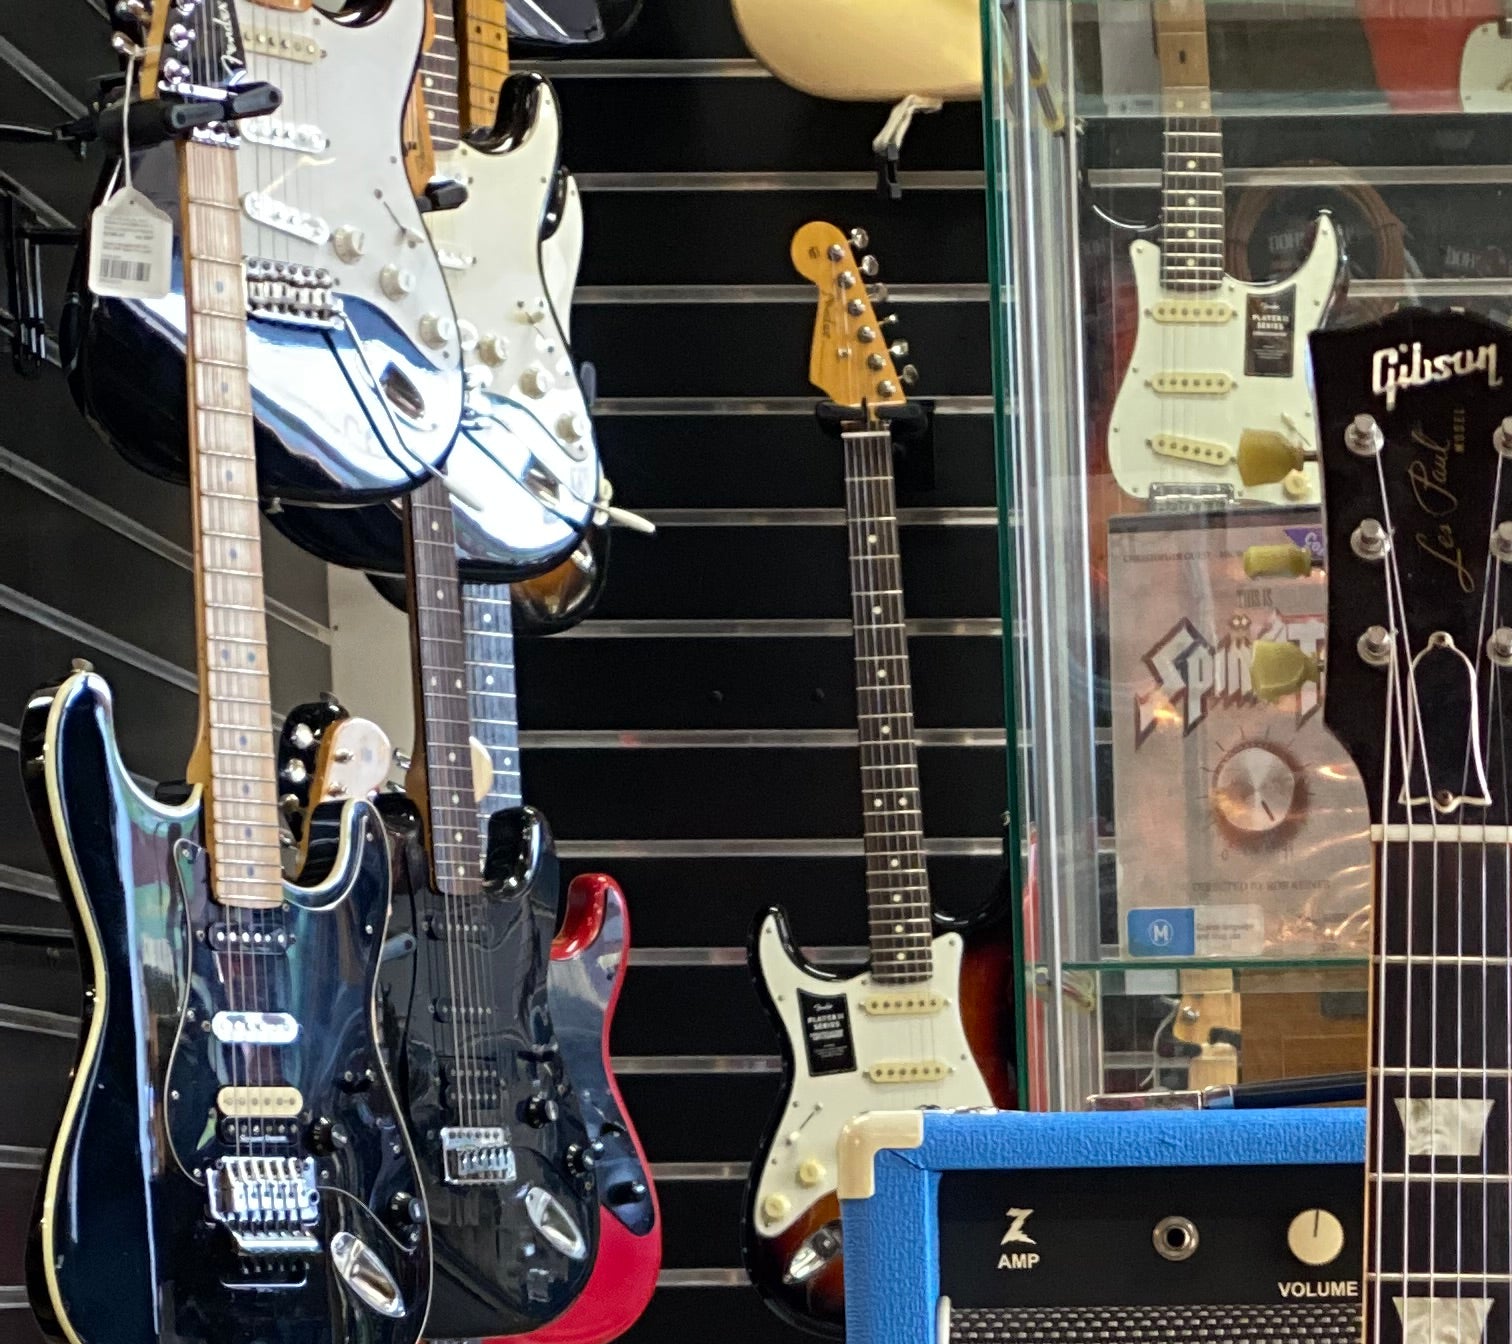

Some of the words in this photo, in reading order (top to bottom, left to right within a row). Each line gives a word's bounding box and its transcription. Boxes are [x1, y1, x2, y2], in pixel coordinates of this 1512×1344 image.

[1372, 341, 1504, 412] Gibson
[1408, 427, 1457, 518] Paul
[1416, 523, 1475, 593] Les
[1236, 588, 1260, 608] THIS
[1261, 588, 1273, 606] IS
[1153, 924, 1169, 941] M
[998, 1252, 1040, 1270] AMP
[1277, 1280, 1359, 1298] VOLUME
